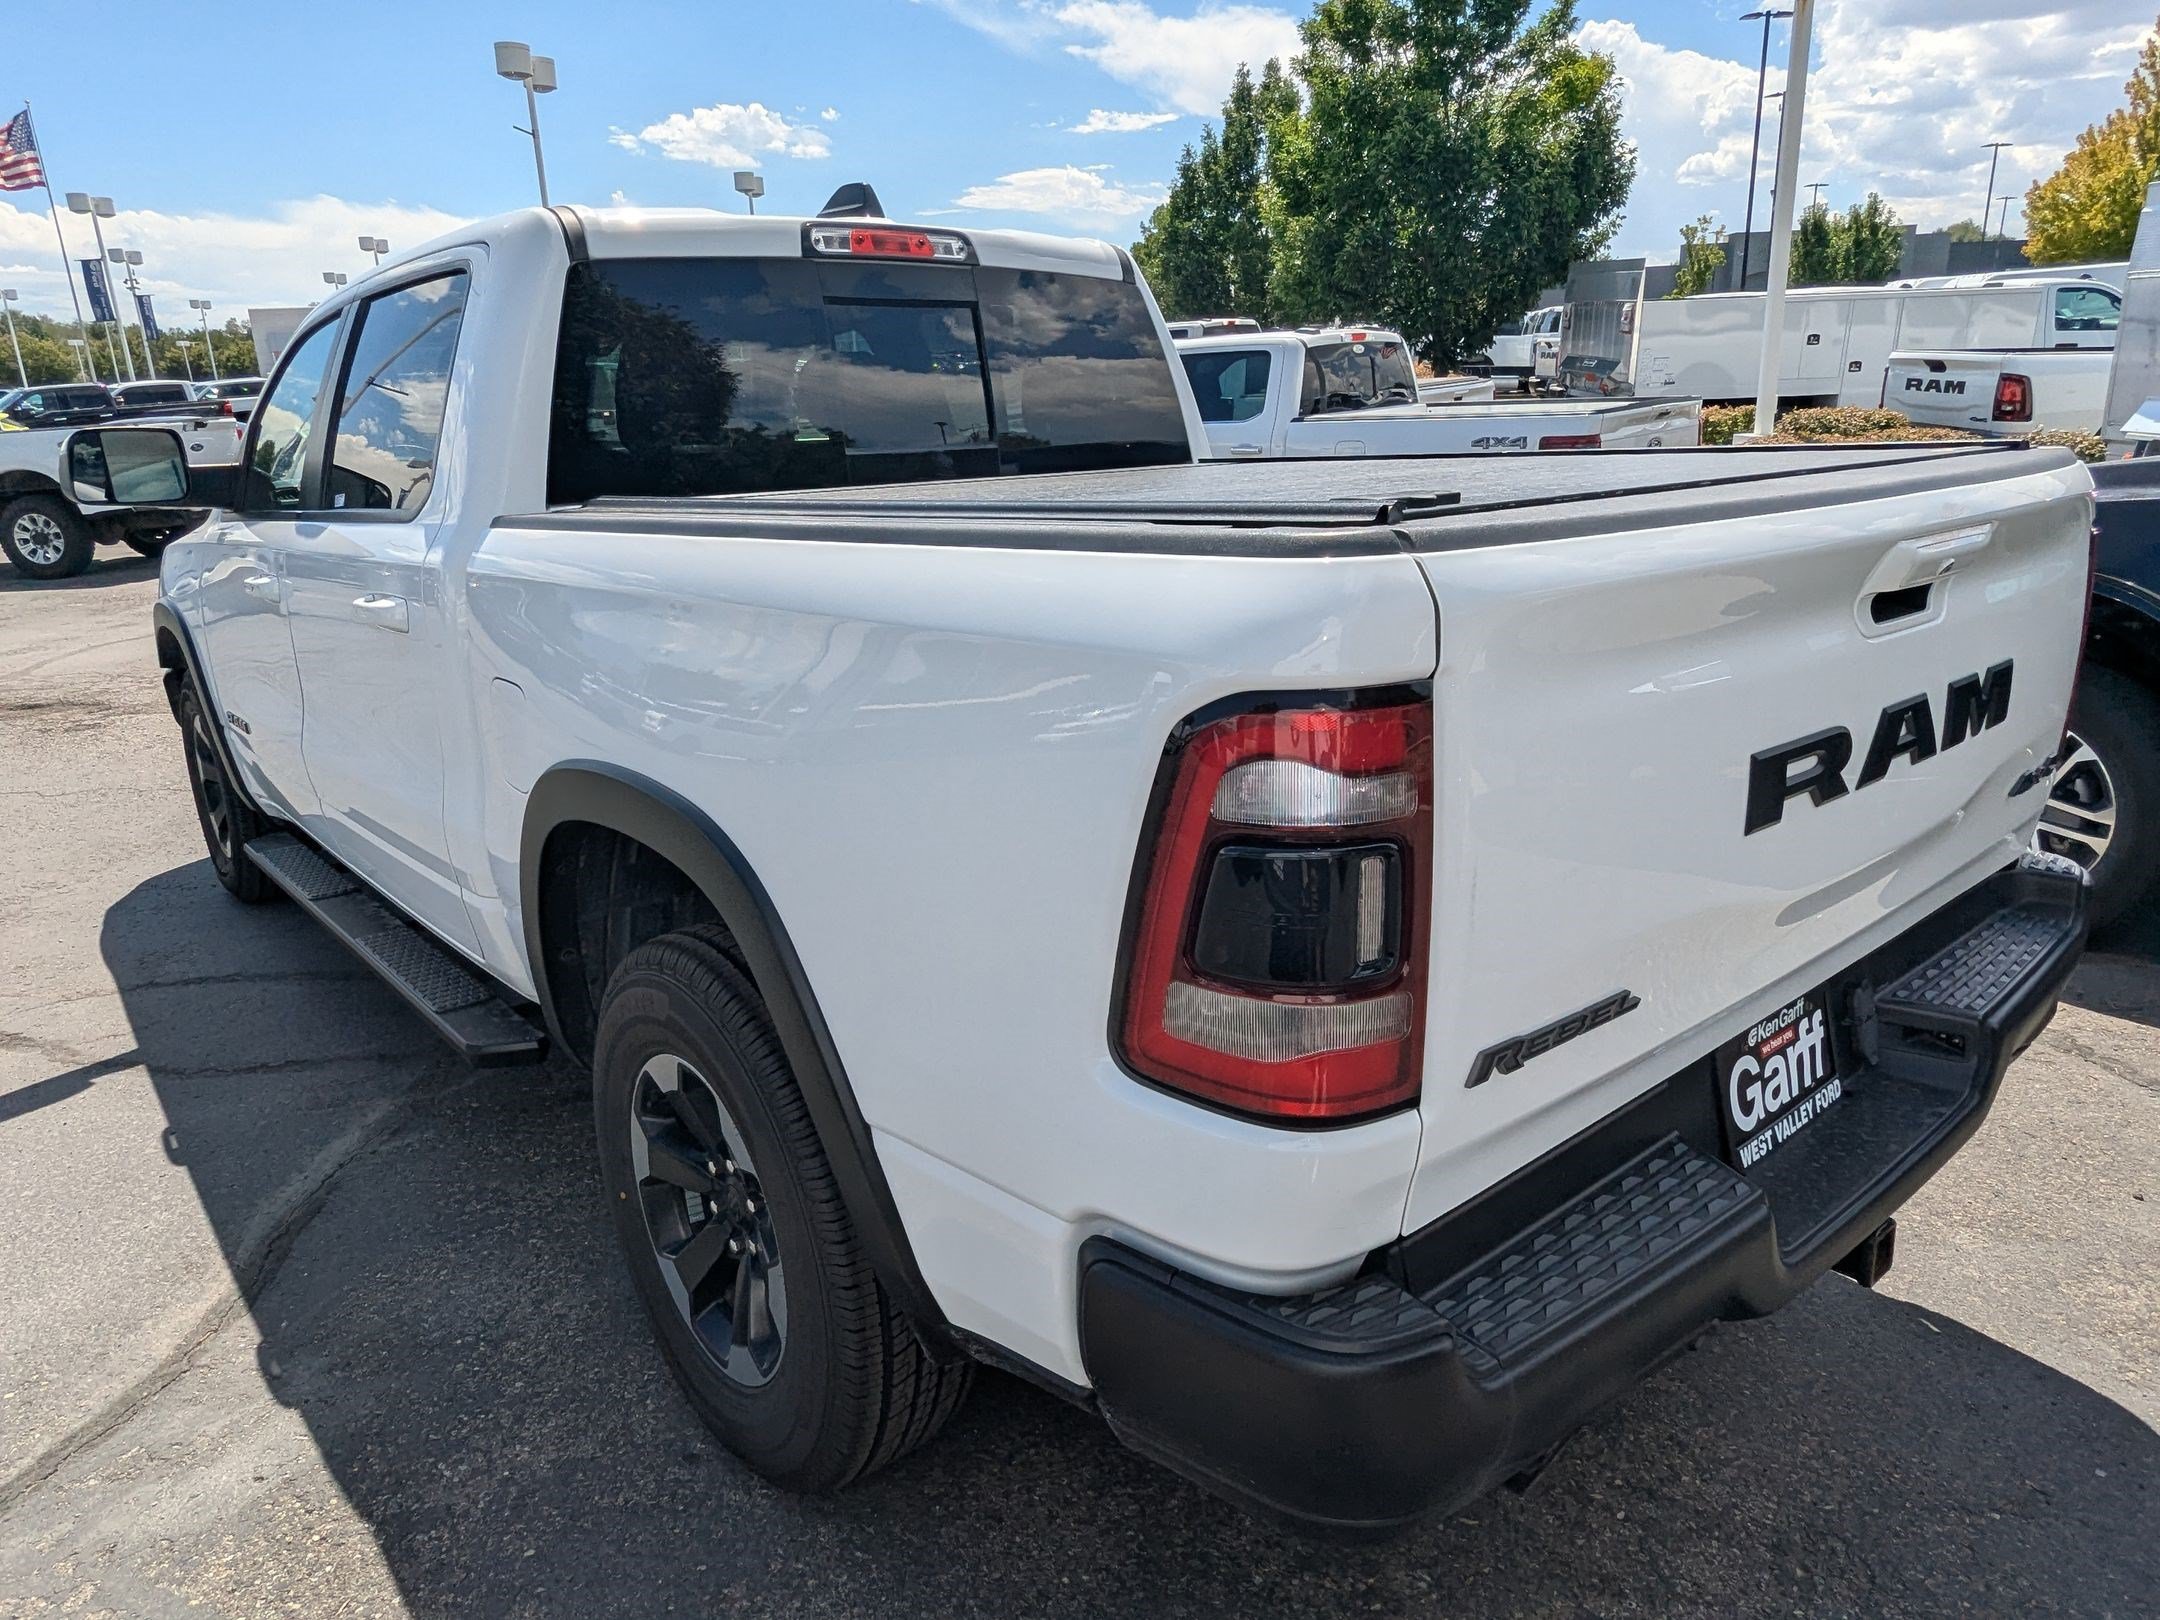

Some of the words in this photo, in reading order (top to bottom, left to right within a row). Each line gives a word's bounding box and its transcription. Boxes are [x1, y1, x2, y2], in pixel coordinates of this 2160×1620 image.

[1905, 378, 1966, 394] RAM
[1744, 658, 2014, 837] RAM
[1757, 1020, 1779, 1042] Ken
[1780, 997, 1804, 1028] Garff
[1783, 1029, 1793, 1044] you
[1729, 1009, 1824, 1132] Garff
[1739, 1128, 1774, 1168] WEST
[1774, 1099, 1816, 1143] VALLEY
[1815, 1078, 1841, 1113] FORD
